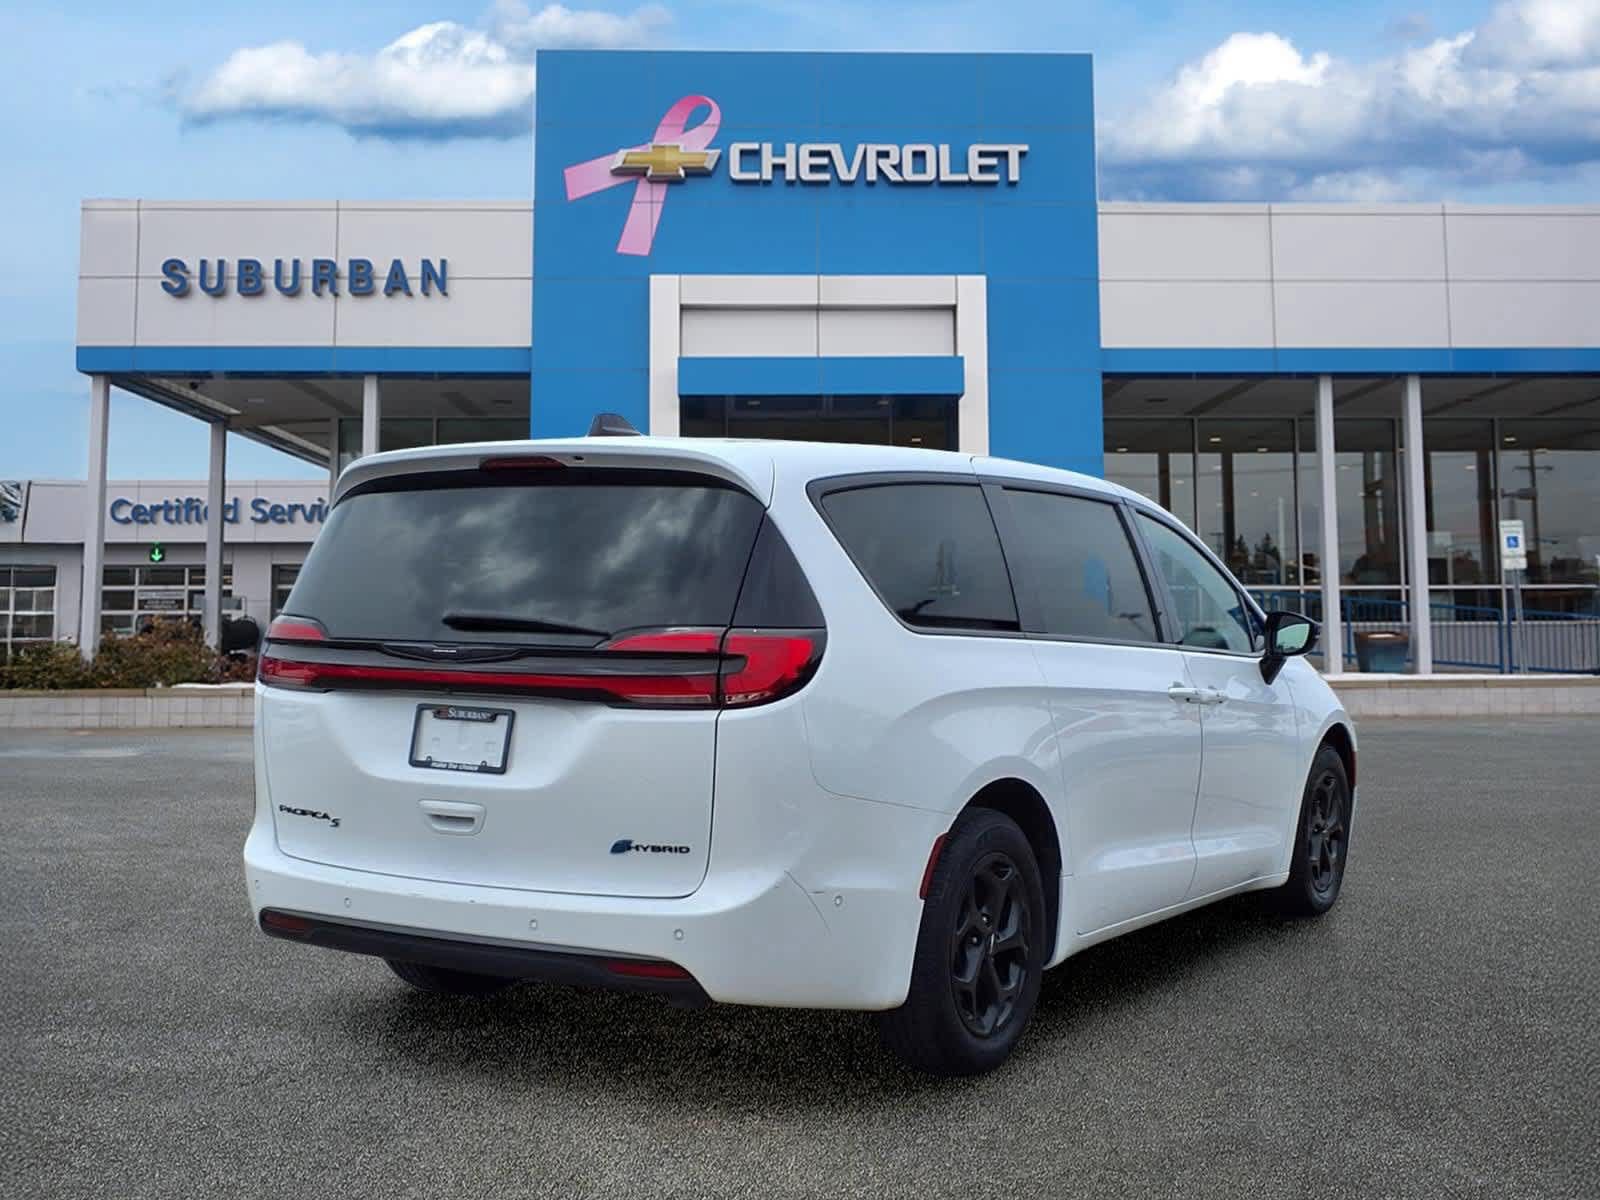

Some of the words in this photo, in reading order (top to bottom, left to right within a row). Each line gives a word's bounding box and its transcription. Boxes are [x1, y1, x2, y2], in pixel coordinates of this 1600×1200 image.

[729, 142, 1029, 183] CHEVROLET
[161, 258, 448, 296] SUBURBAN
[110, 497, 240, 524] Certifid
[279, 804, 331, 820] PACIFICA
[329, 818, 341, 828] S
[630, 844, 691, 854] HYBRID
